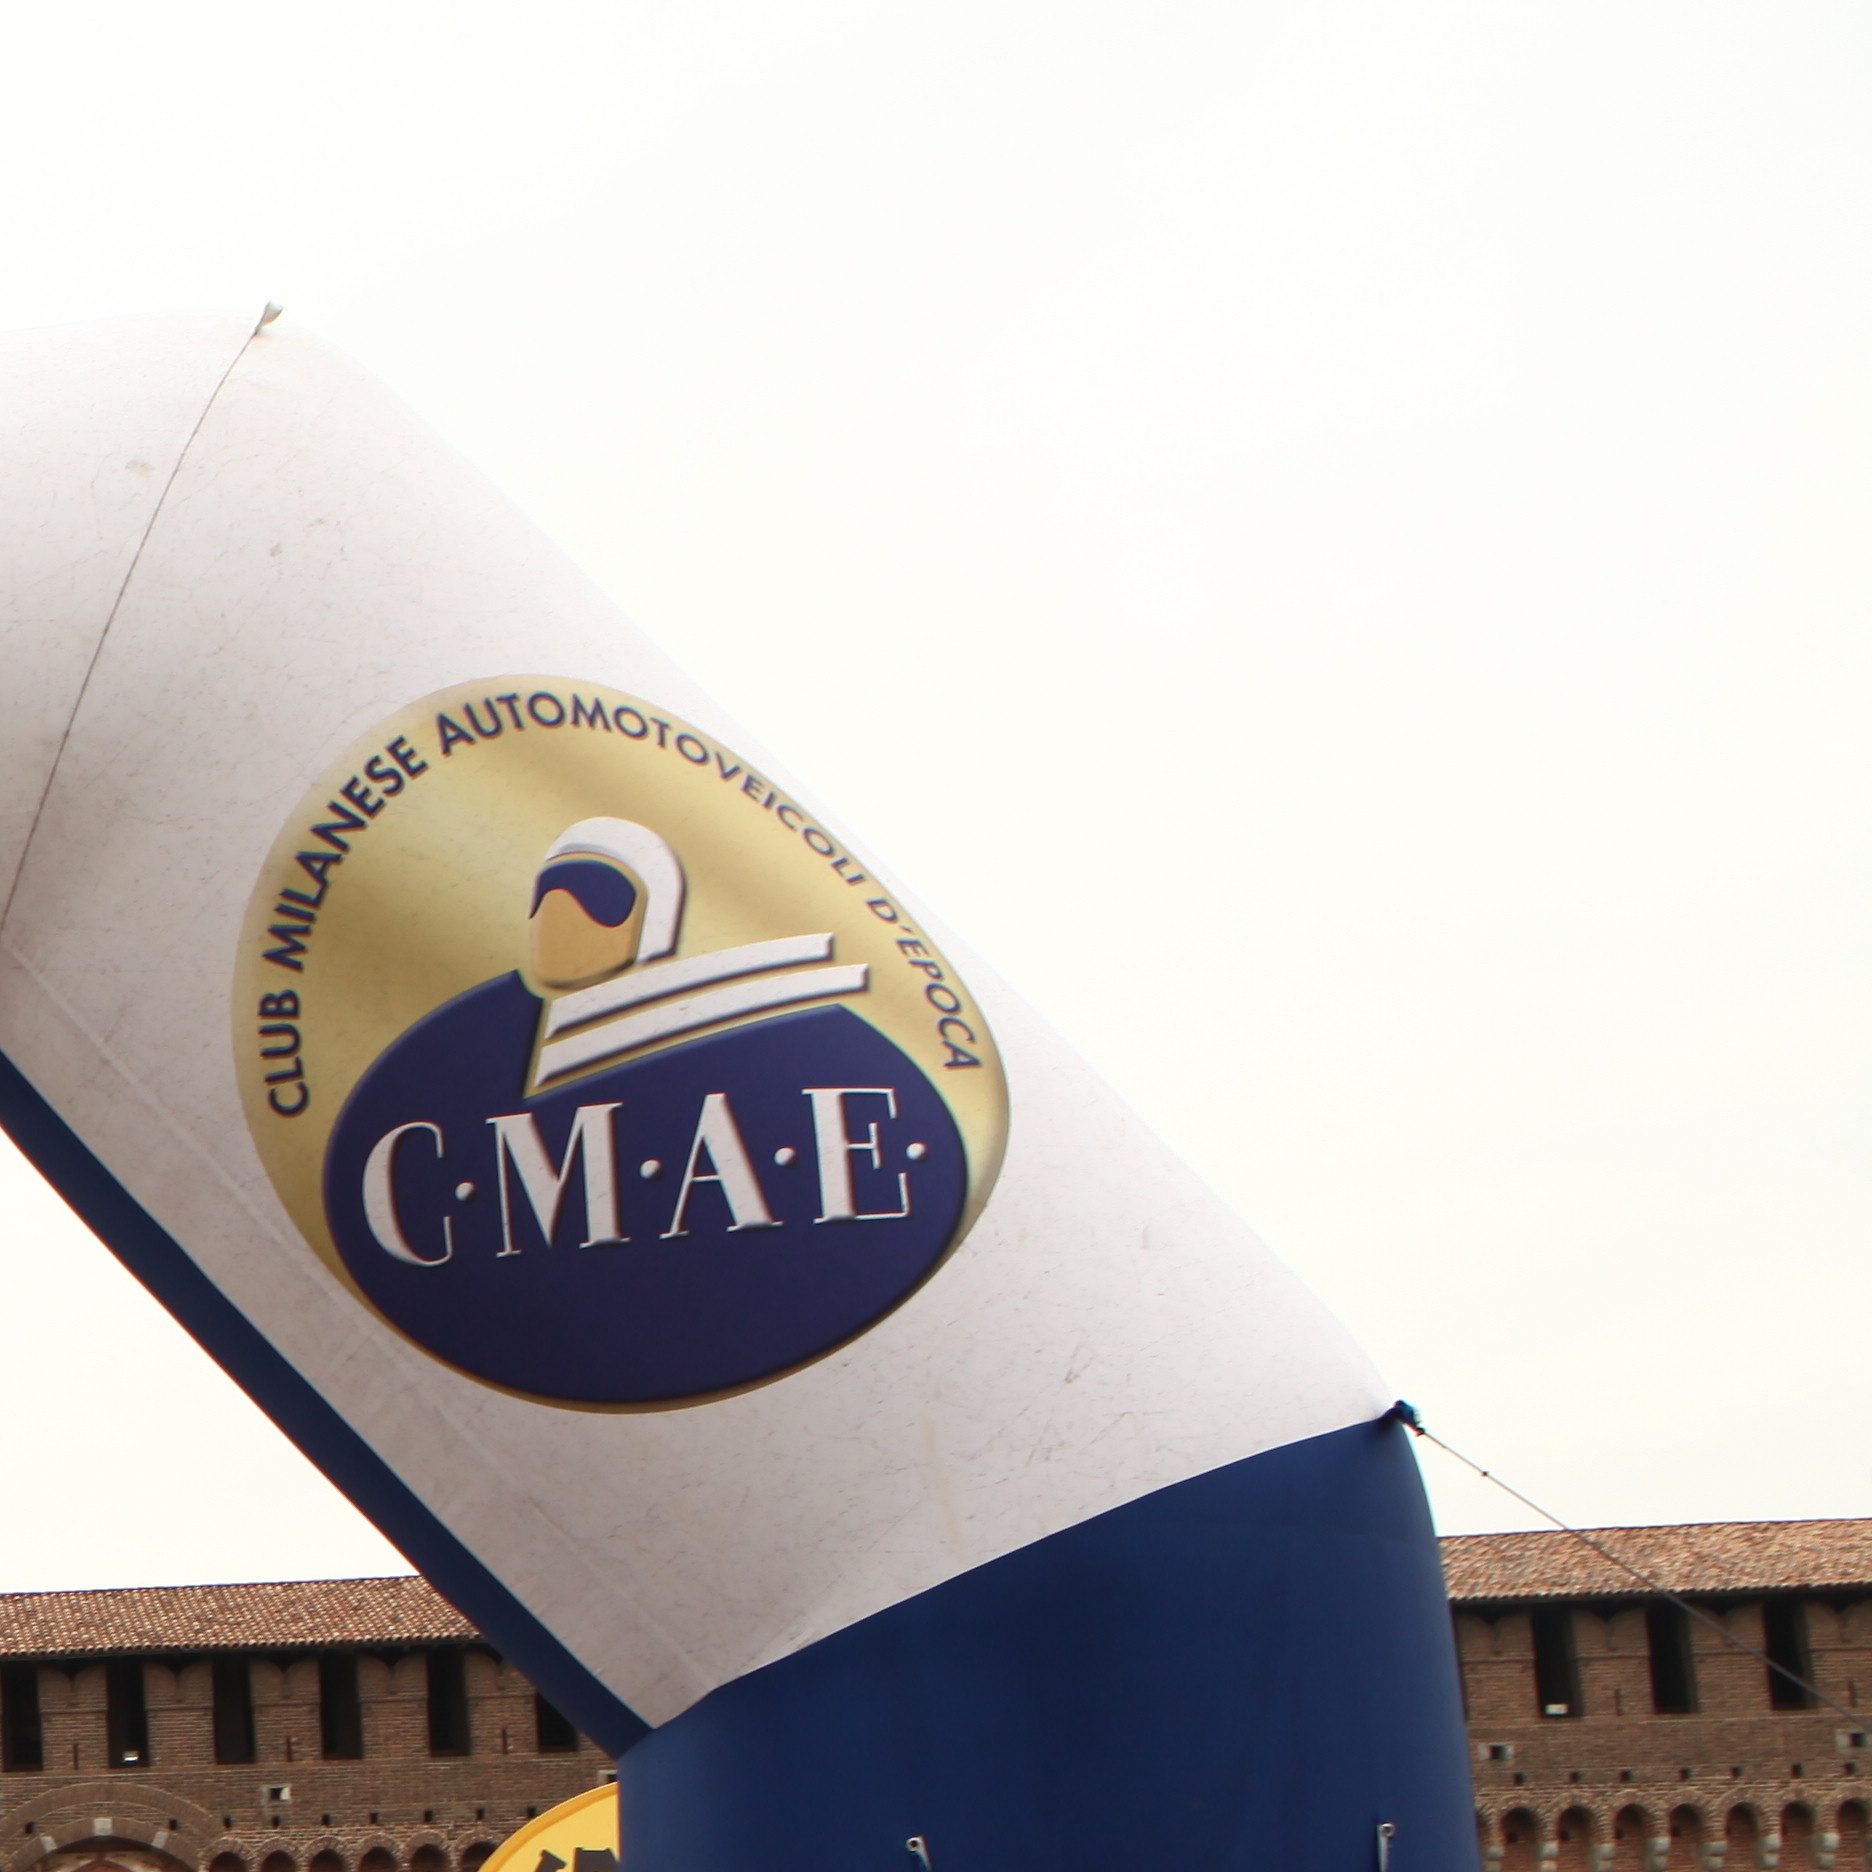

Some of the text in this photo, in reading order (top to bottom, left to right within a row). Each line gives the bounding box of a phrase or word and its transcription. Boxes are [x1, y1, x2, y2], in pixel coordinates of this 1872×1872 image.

[260, 690, 981, 1118] CLUB MILANESE AUTOMOTOVEICOLI D'EPOCA
